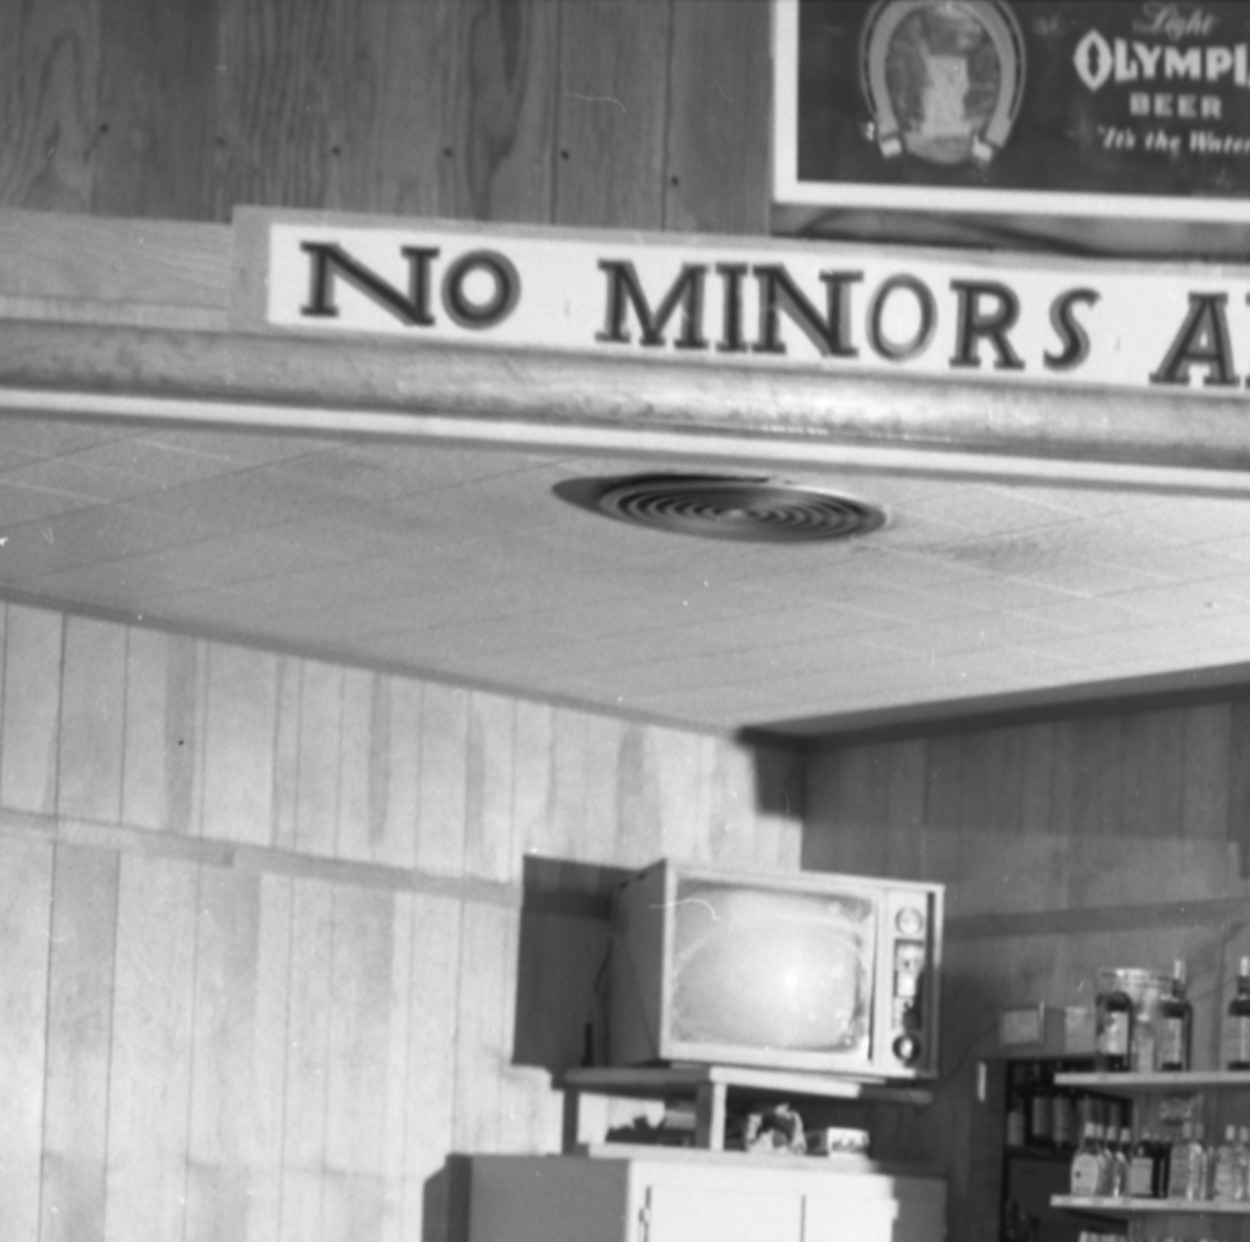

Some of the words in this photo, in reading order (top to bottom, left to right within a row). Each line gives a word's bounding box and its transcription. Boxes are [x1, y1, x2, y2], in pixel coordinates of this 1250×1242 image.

[1133, 2, 1215, 41] Light
[1128, 91, 1223, 120] BEER
[1144, 128, 1181, 153] the
[300, 241, 521, 331] NO
[595, 258, 1100, 371] MINORS
